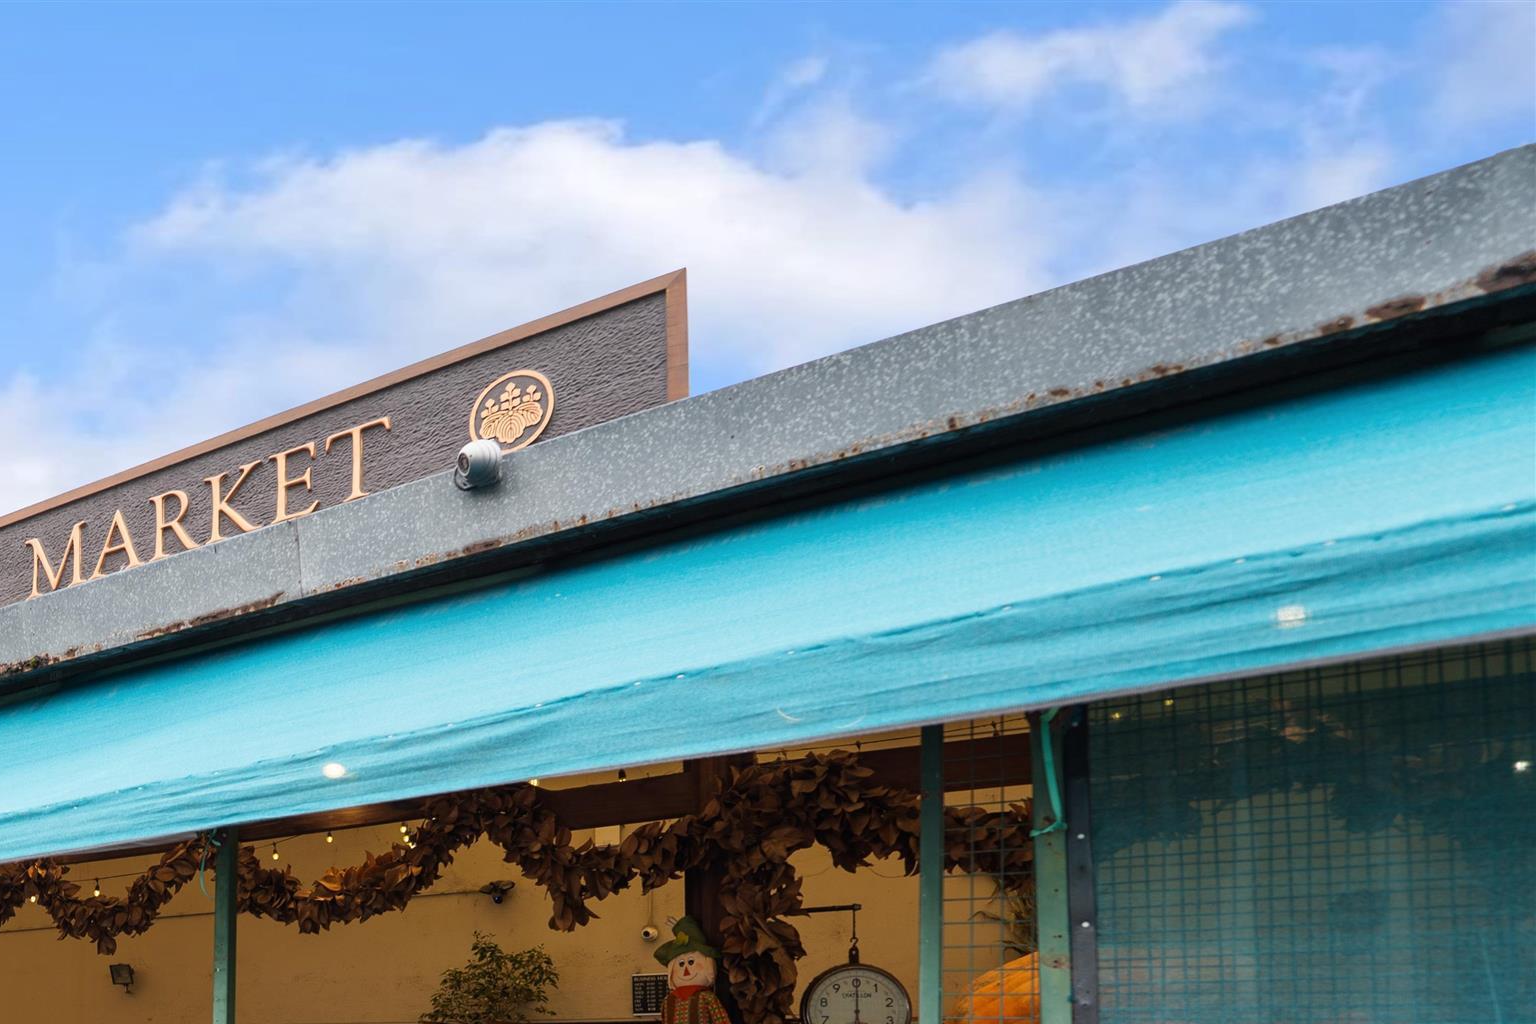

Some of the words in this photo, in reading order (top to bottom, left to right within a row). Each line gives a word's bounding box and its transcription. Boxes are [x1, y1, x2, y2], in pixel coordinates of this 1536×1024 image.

[25, 416, 392, 600] MARKET
[833, 984, 841, 993] 9
[873, 984, 879, 993] 1
[820, 998, 828, 1008] 8
[885, 998, 894, 1008] 2
[821, 1016, 829, 1024] 7
